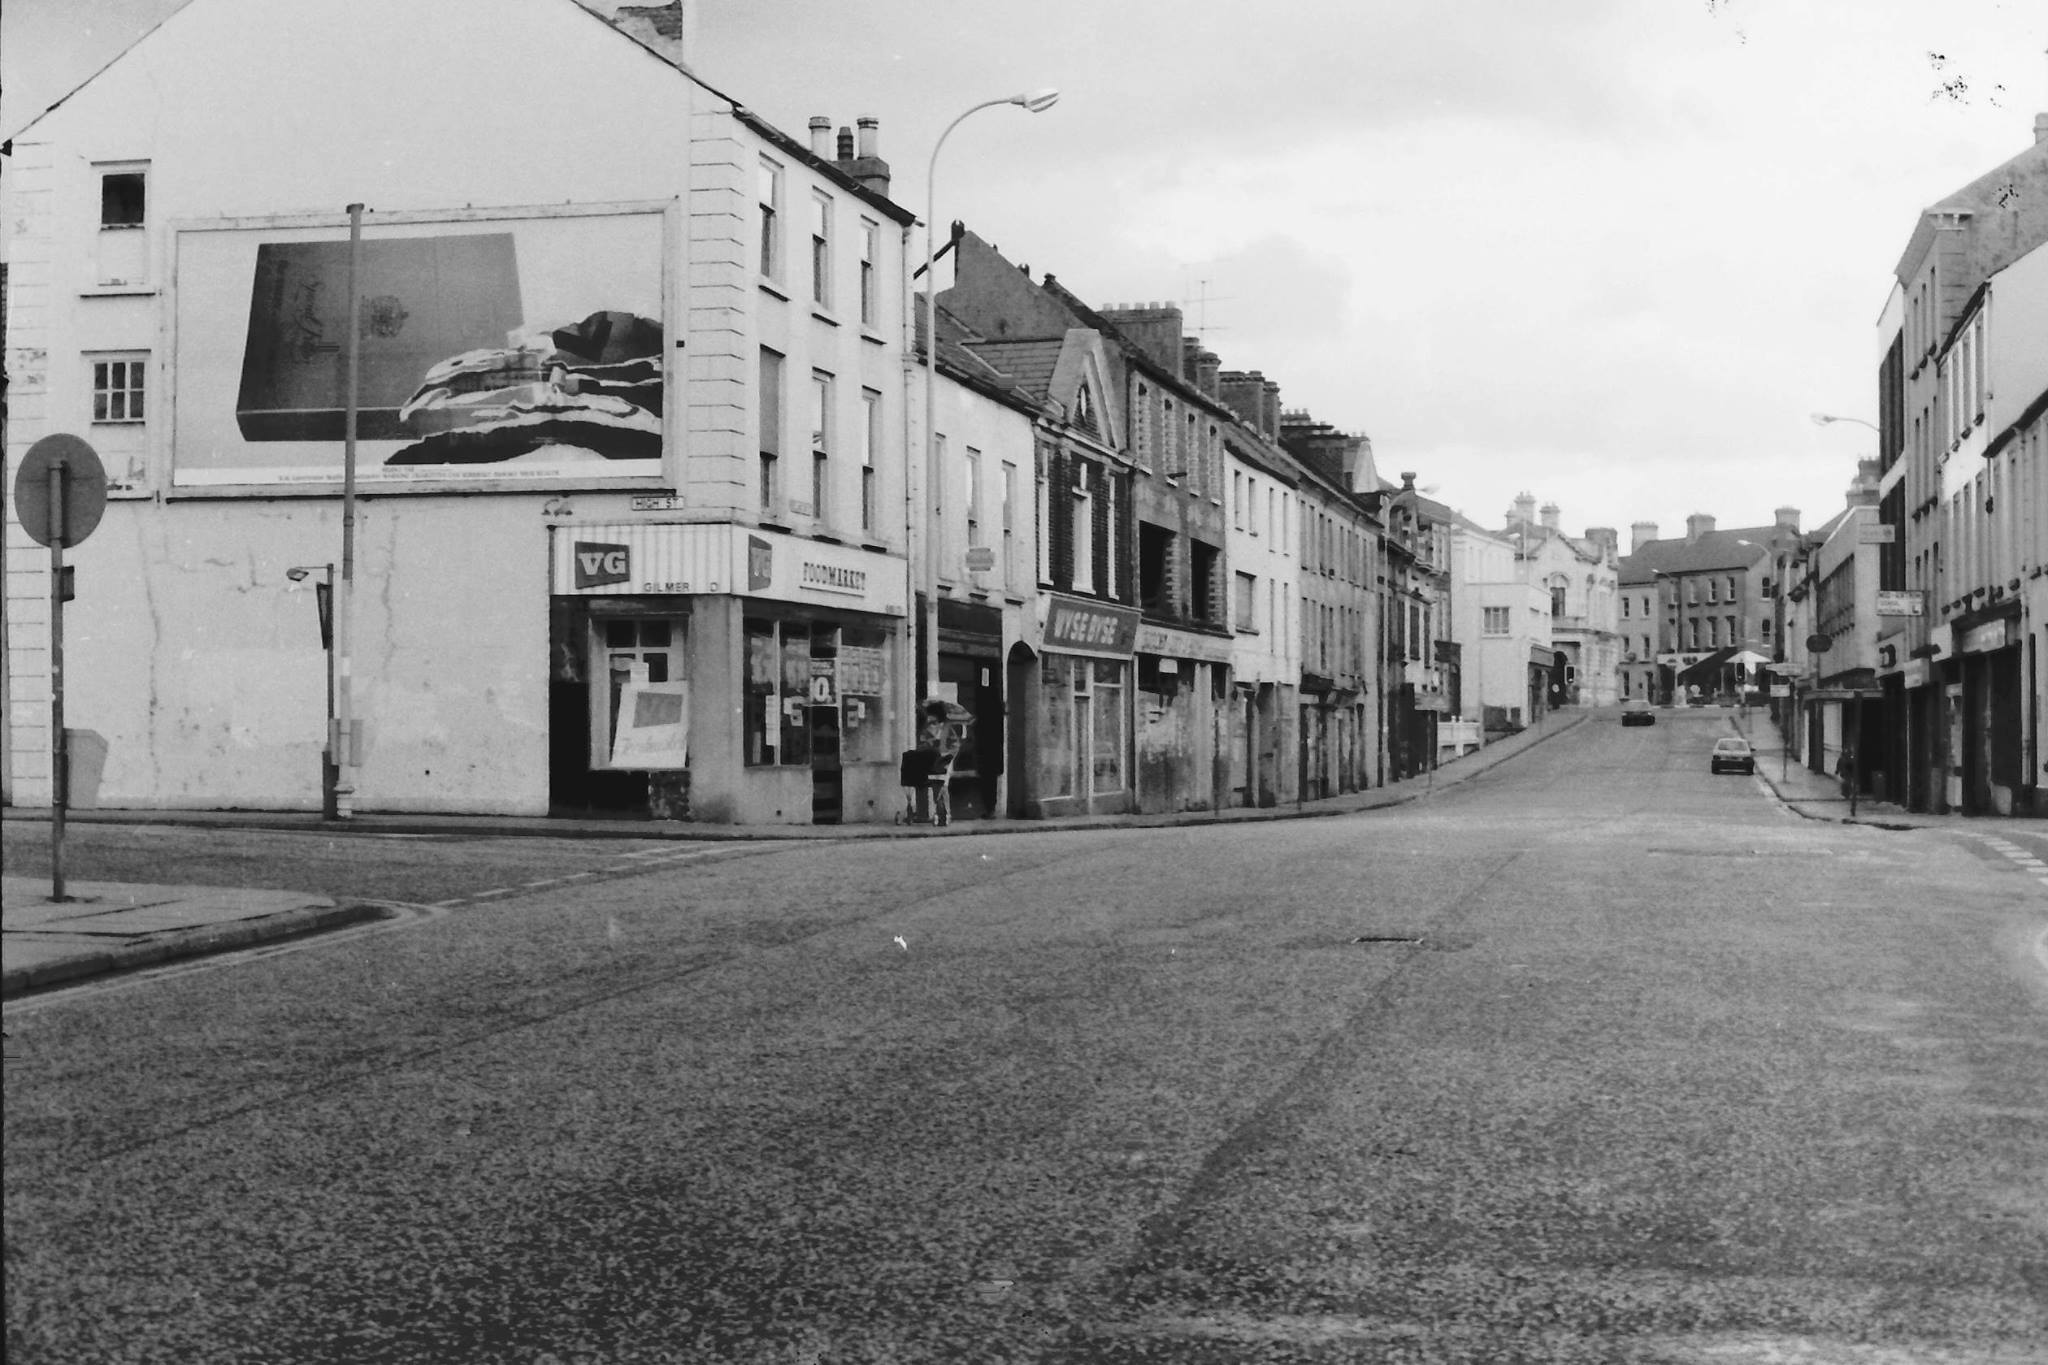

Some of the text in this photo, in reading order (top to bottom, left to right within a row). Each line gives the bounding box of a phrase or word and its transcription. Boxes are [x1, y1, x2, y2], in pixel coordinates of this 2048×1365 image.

[635, 498, 662, 509] HIGH
[577, 551, 627, 576] VG
[803, 561, 867, 591] FOODMARKET
[643, 582, 691, 592] GILMER
